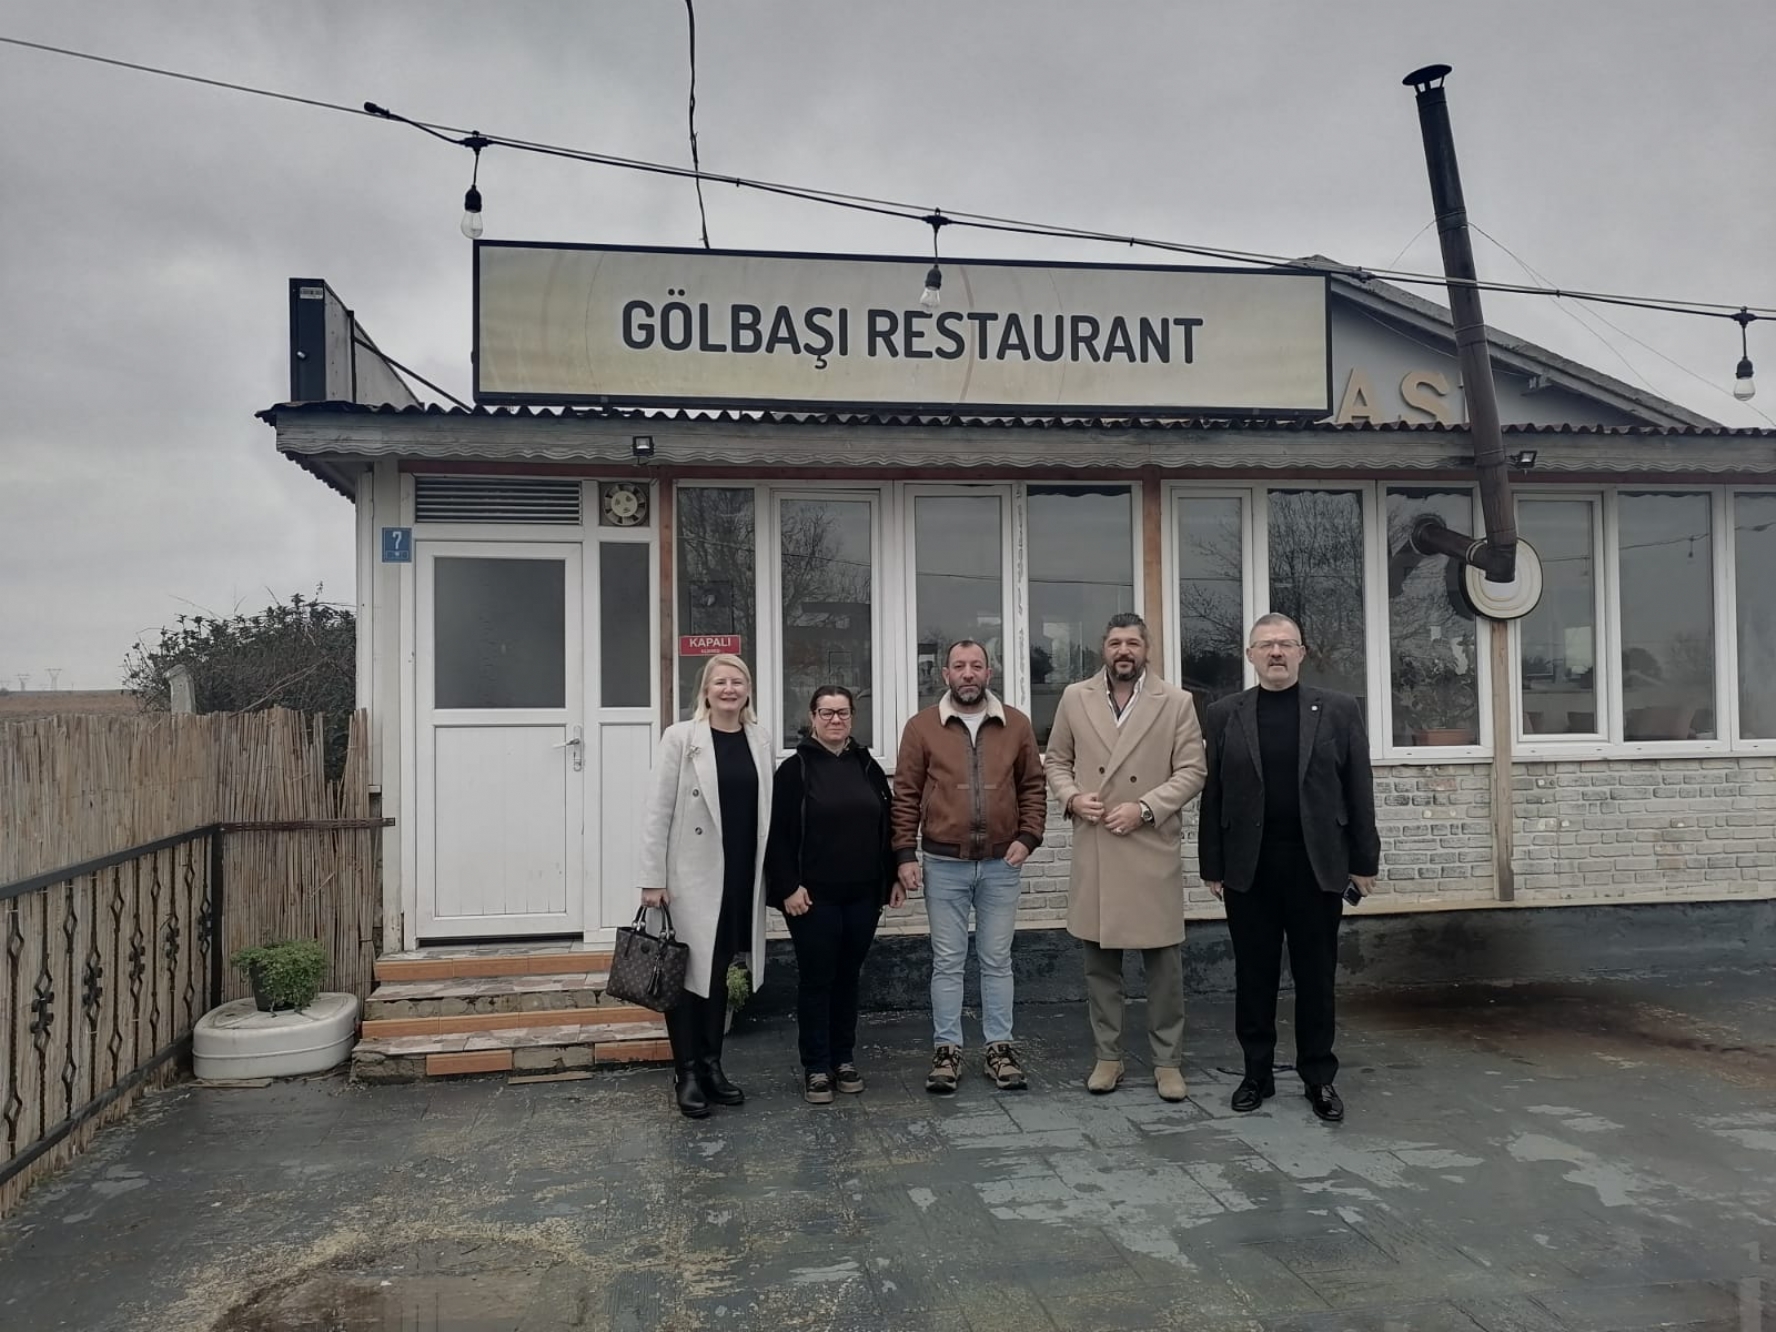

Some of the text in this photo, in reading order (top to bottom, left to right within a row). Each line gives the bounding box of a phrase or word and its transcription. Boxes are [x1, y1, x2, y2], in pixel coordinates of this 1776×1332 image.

[622, 288, 1204, 370] GÖLBAŞI RESTAURANT
[392, 531, 402, 550] 7
[689, 637, 731, 648] KAPALI
